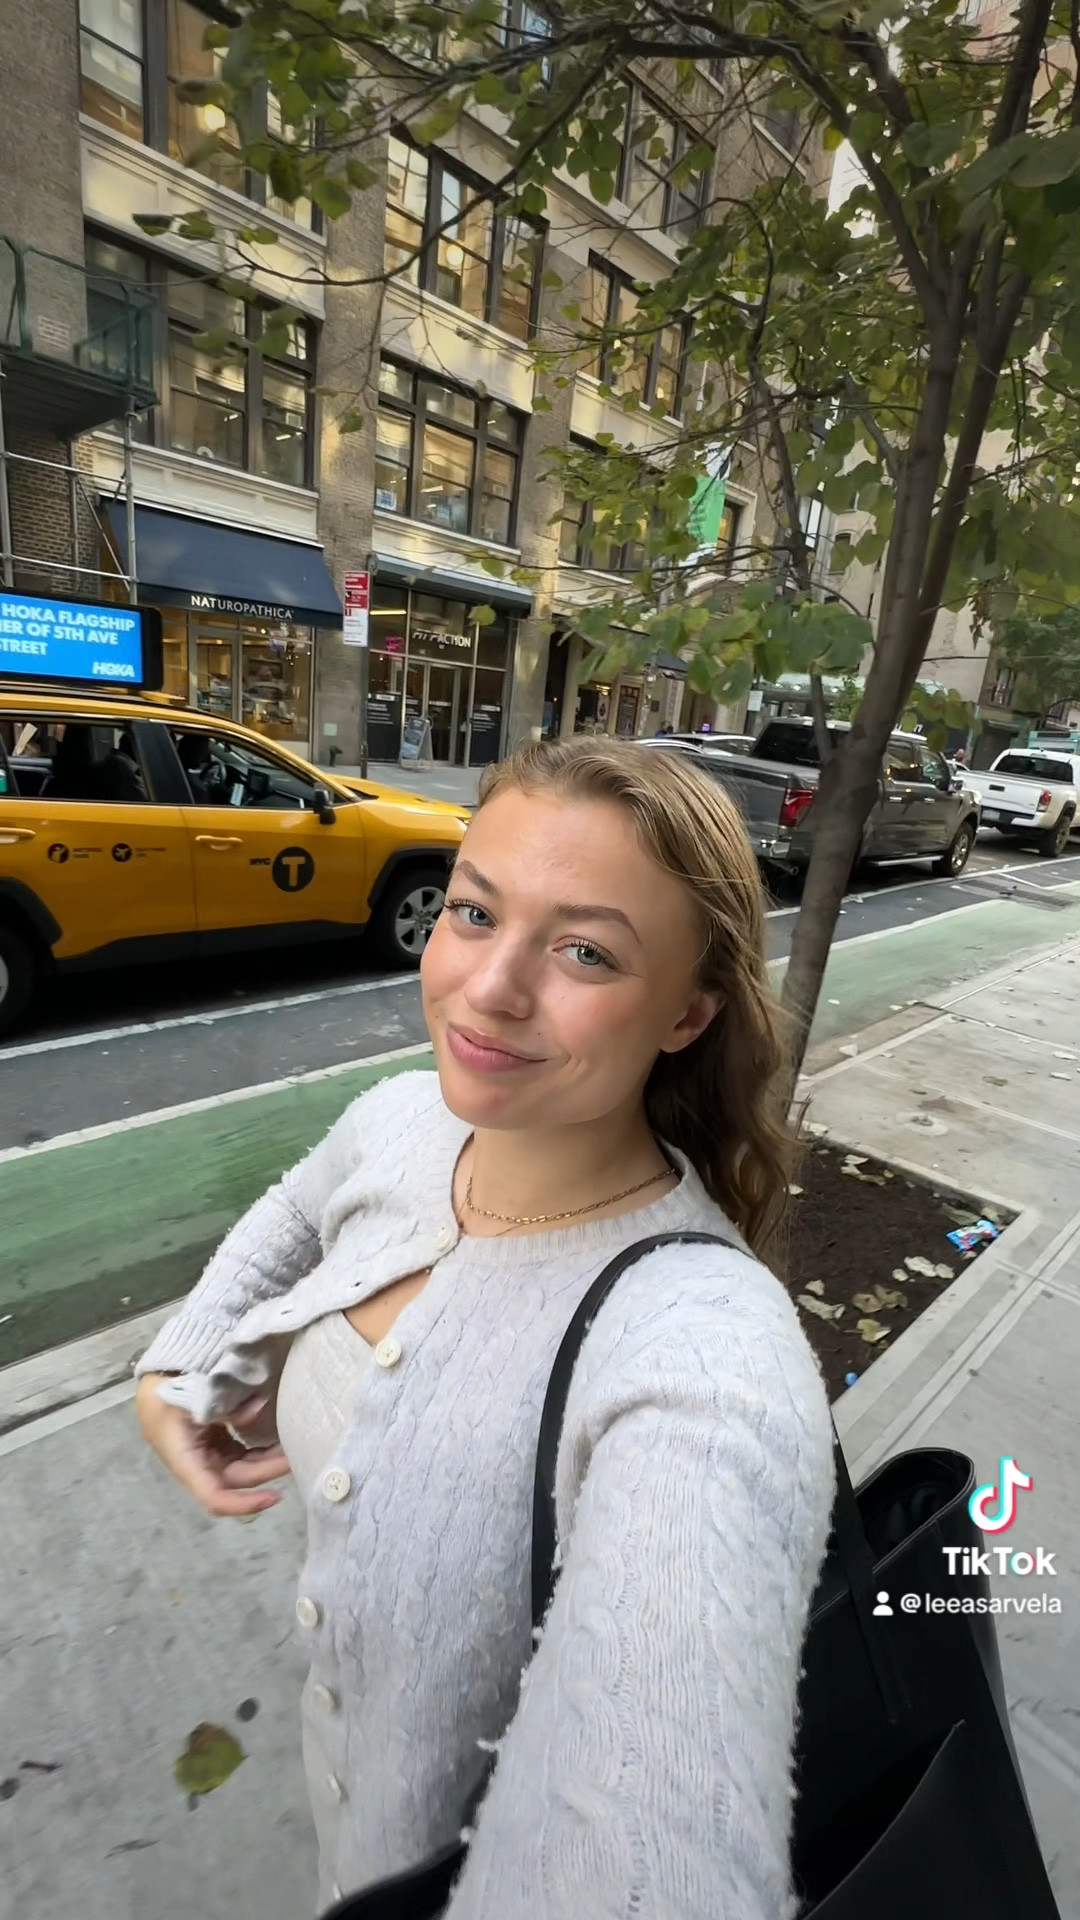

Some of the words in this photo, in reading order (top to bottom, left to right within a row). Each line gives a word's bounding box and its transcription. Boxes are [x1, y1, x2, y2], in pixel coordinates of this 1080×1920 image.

[1, 603, 56, 623] HOKA
[58, 610, 135, 631] FLAGSHIP
[191, 595, 293, 619] NATUROPATHICA
[0, 620, 25, 635] ER
[26, 622, 51, 637] OF
[53, 625, 84, 641] 5TH
[87, 631, 118, 645] AVE
[92, 661, 135, 677] HOKA
